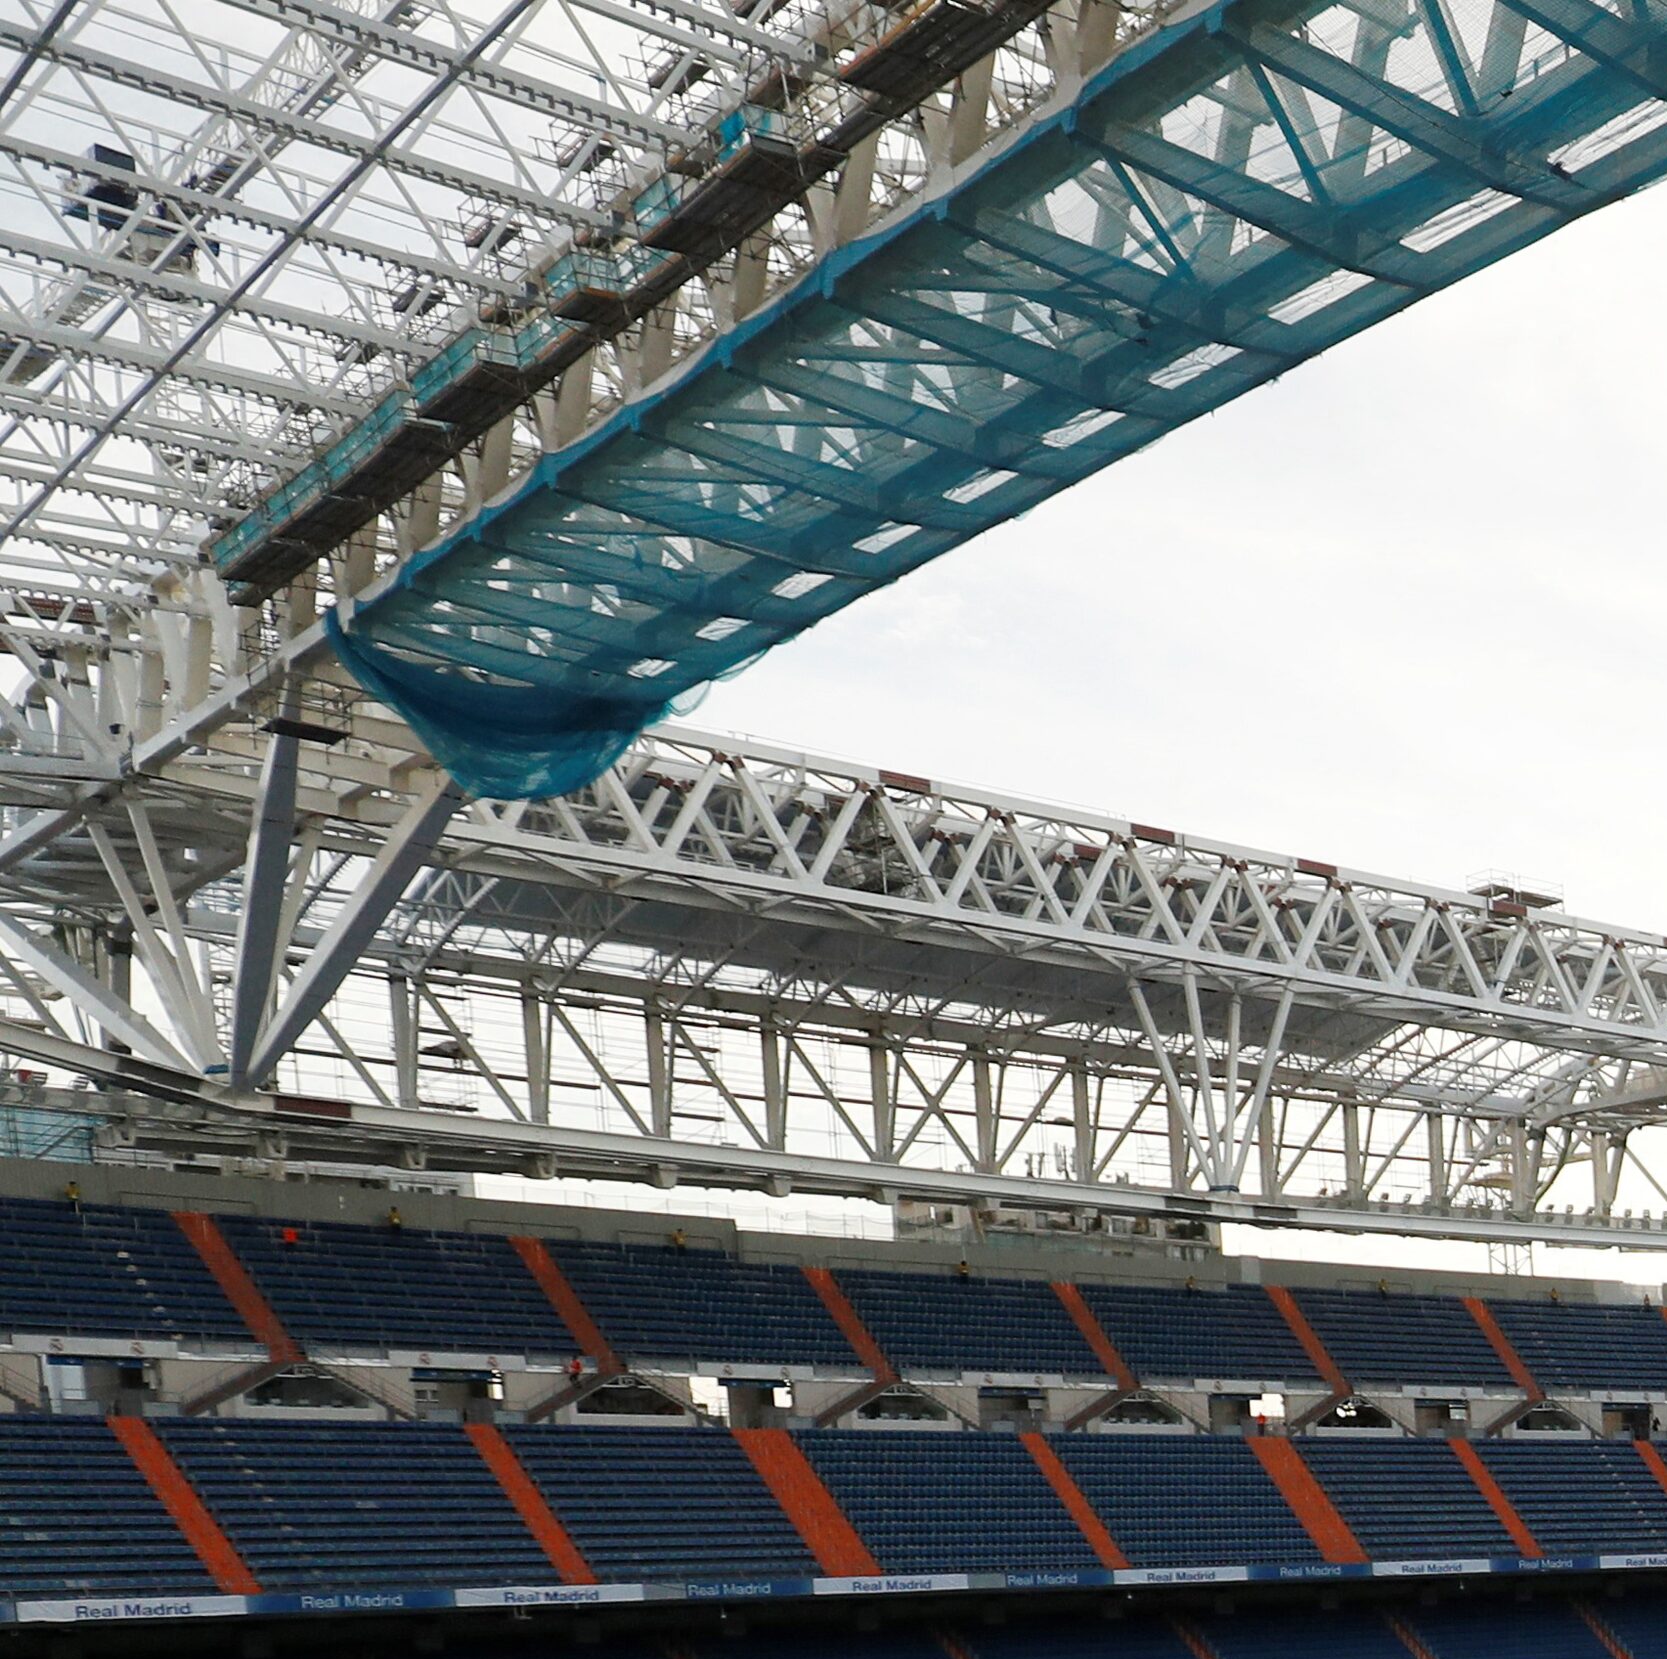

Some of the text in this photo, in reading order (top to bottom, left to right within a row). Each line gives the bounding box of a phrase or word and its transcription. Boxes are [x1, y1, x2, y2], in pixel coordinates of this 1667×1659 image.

[1402, 1562, 1462, 1574] Real Madrid
[1519, 1558, 1573, 1570] Real Madrid
[1626, 1558, 1646, 1567] Real
[1147, 1570, 1216, 1582] Real Madrid
[1280, 1565, 1341, 1576] Real Madrid
[853, 1578, 932, 1592] Real Madrid
[1008, 1573, 1078, 1585] Real Madrid
[688, 1582, 771, 1596] Real Madrid
[302, 1594, 403, 1609] Real Madrid
[504, 1590, 599, 1604] Real Madrid
[75, 1602, 191, 1619] Real Madrid
